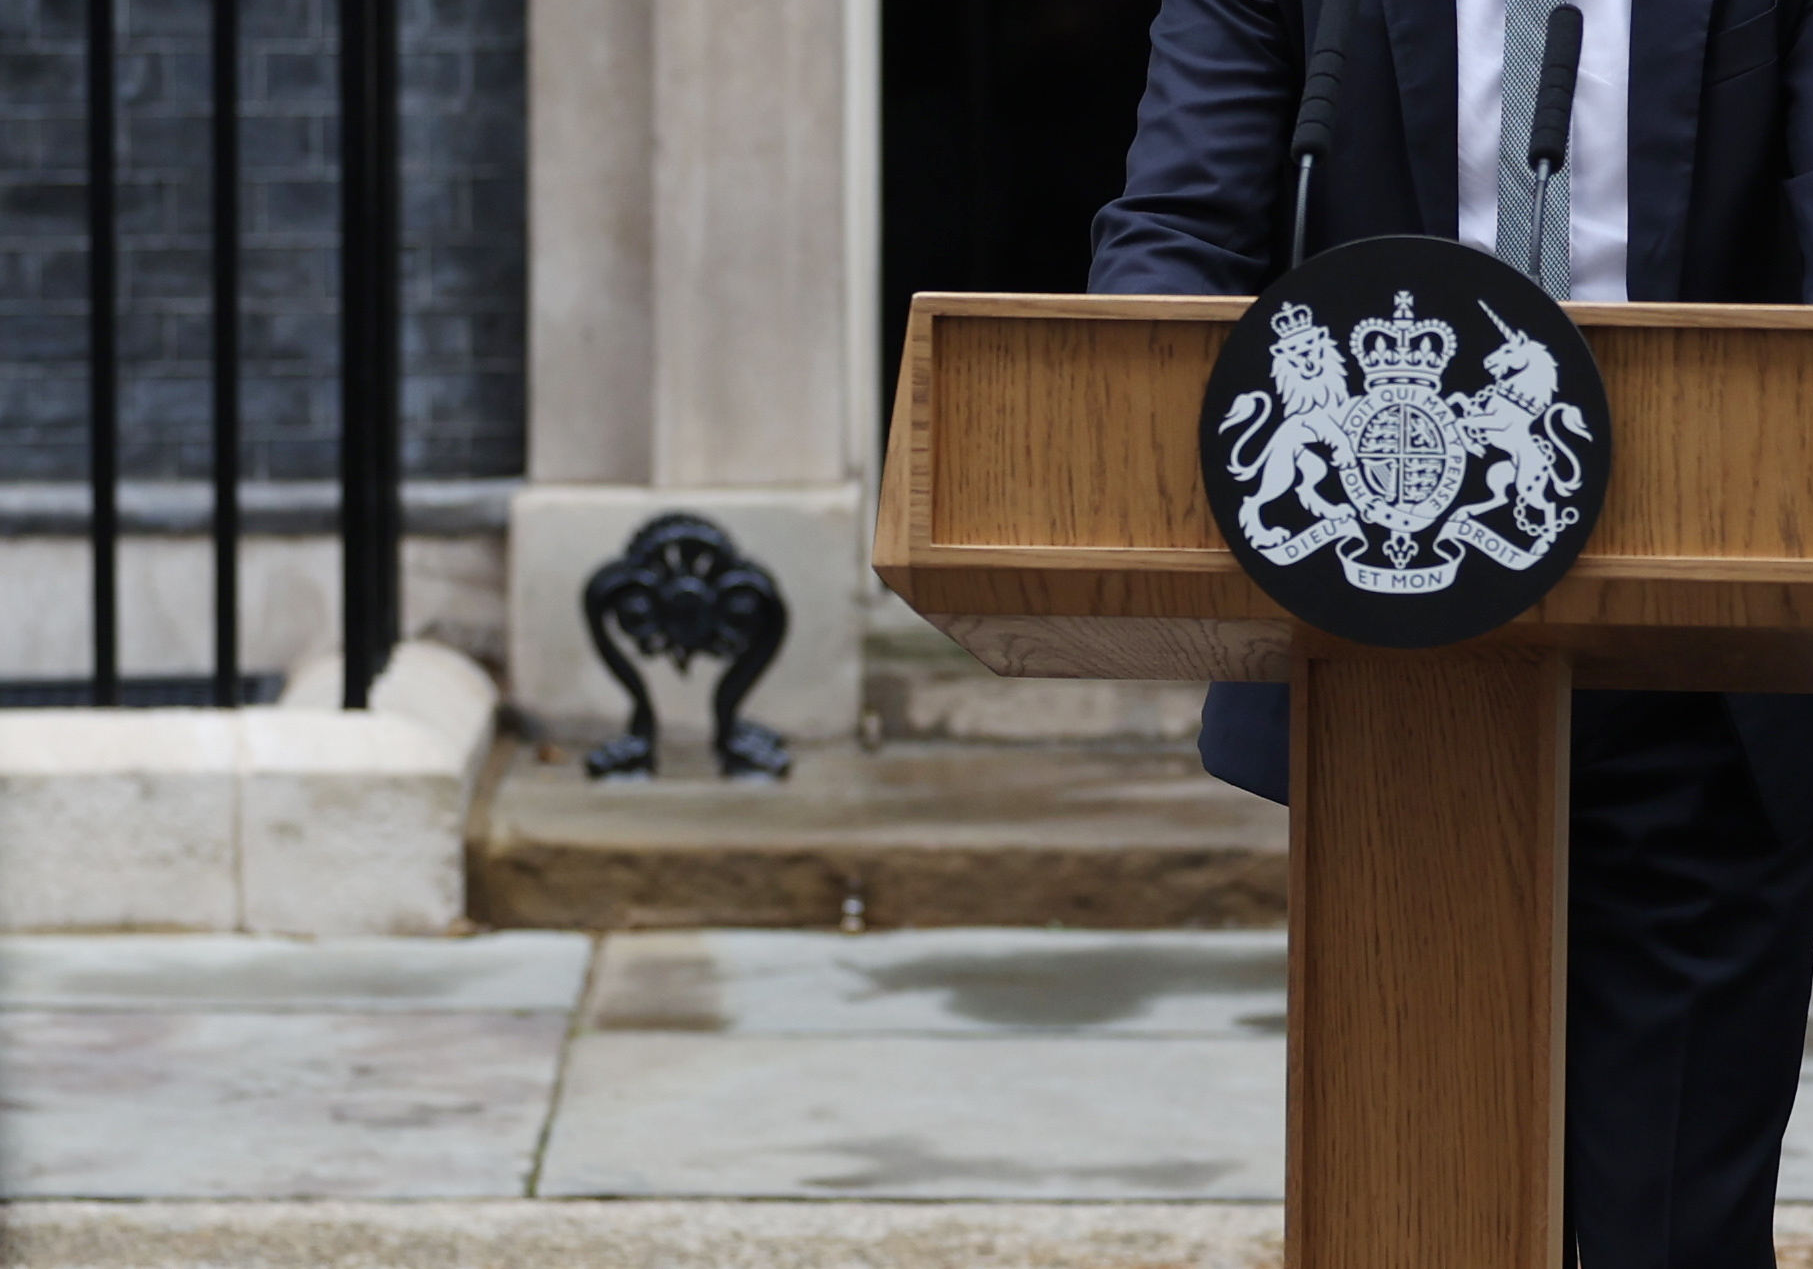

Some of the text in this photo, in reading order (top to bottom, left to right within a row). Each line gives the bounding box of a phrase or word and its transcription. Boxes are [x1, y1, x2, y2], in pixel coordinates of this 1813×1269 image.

[1380, 388, 1417, 403] QUI
[1422, 395, 1455, 433] MAL
[1344, 399, 1376, 437] SOIT
[1449, 437, 1462, 446] Y
[1428, 455, 1463, 511] PENSE
[1284, 518, 1521, 589] DIEU ET MON DROIT
